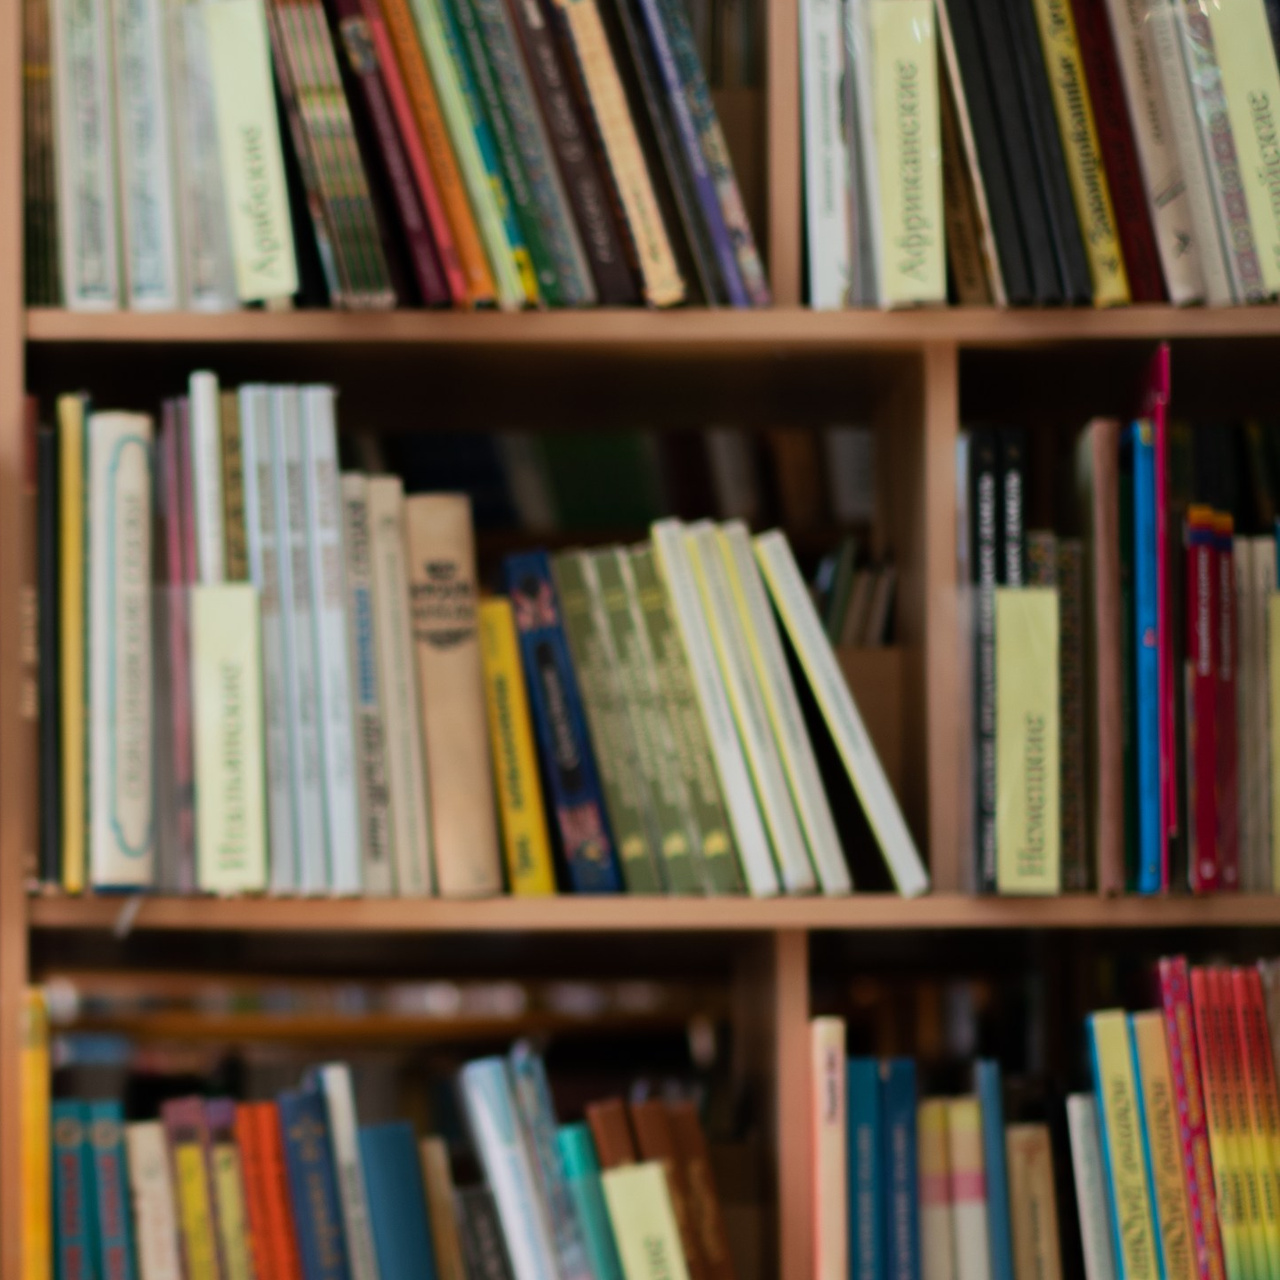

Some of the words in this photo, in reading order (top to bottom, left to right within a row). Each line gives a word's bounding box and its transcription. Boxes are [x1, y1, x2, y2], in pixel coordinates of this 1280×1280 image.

[239, 123, 281, 278] Арабские
[894, 59, 933, 282] Африканские
[1016, 710, 1046, 877] Немецкие
